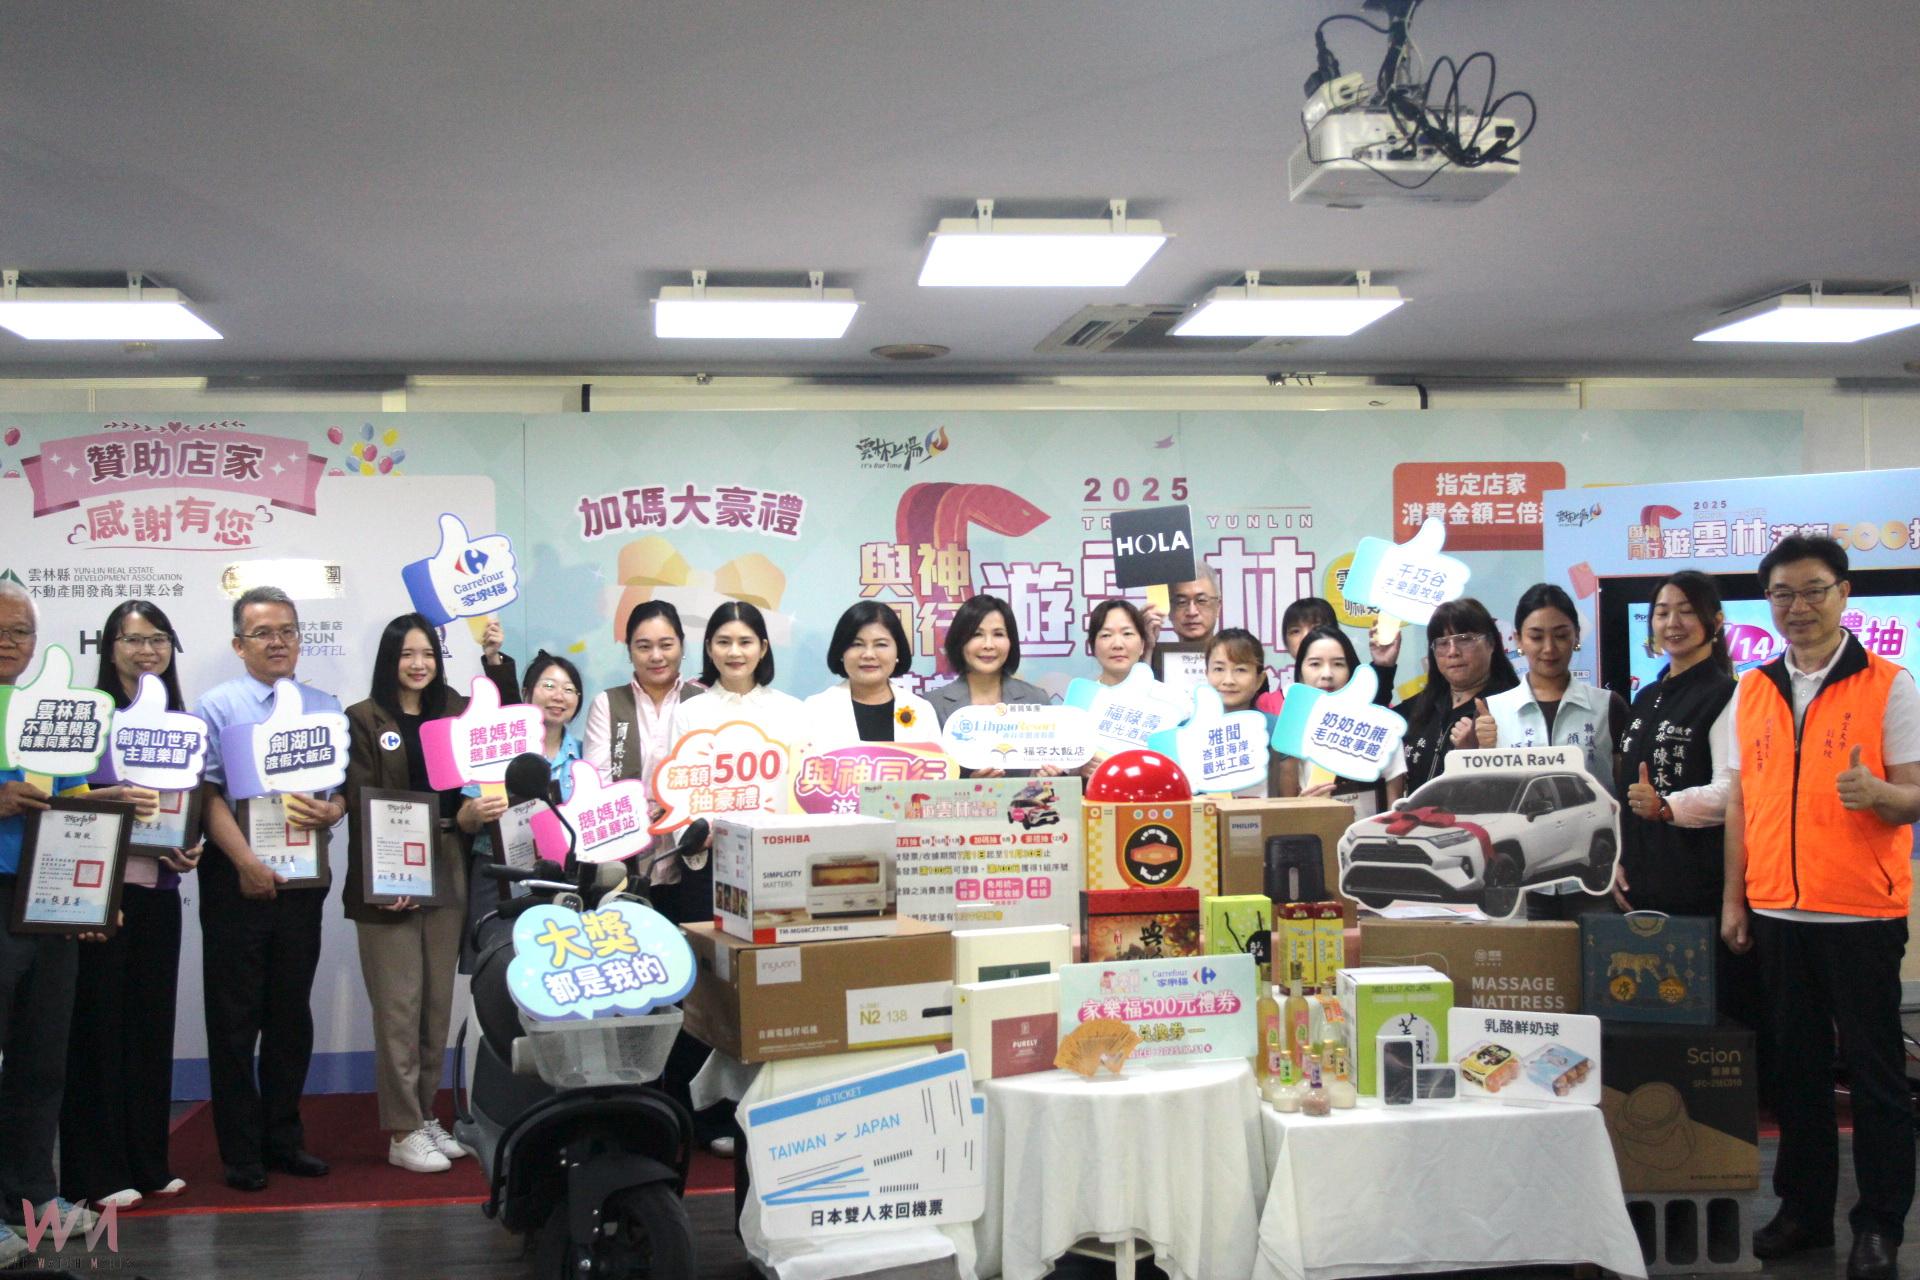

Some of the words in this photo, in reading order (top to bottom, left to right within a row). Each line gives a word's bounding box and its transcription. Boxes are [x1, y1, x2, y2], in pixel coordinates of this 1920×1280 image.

[1083, 477, 1189, 502] 2025
[1436, 472, 1527, 496] 指定店家
[578, 484, 803, 537] 加碼大豪禮
[1403, 502, 1543, 526] 消費金額三倍
[1694, 501, 1727, 510] 2025
[87, 496, 255, 545] 感謝有您
[1207, 515, 1314, 529] YUNLIN
[1116, 530, 1190, 557] HOLA
[28, 568, 71, 582] 雲林縣
[453, 570, 506, 595] Carrefour
[29, 583, 184, 598] 不動產開發商業同業公會
[460, 582, 508, 606] 家樂福
[36, 701, 94, 720] 雲林縣
[25, 719, 99, 737] 不動產開發
[118, 729, 198, 748] 劍湖山世界
[469, 719, 527, 747] 鵝媽媽
[1208, 723, 1241, 745] 雅聞
[1320, 711, 1388, 744] 奶奶的熊
[20, 735, 95, 749] 商業同業公會
[269, 727, 330, 753] 劍湖山
[469, 739, 527, 762] 鵝童樂園
[1314, 727, 1381, 756] 毛巾故事館
[125, 748, 188, 764] 主題樂園
[265, 748, 333, 770] 渡假大飯店
[1463, 755, 1523, 768] TOYOTA
[1527, 752, 1565, 766] Rav4
[667, 750, 781, 788] 滿額500
[690, 786, 760, 813] 抽豪禮
[578, 796, 633, 831] 鵝媽媽
[582, 815, 637, 846] 鵝童驛站
[1231, 822, 1259, 830] PHILIPS
[762, 834, 811, 845] TOSHIBA
[762, 870, 802, 879] SIMPLICITY
[536, 910, 640, 967] 大獎
[545, 955, 668, 1004] 都是我的
[1152, 969, 1188, 978] Carrefour
[1472, 977, 1555, 991] MASSAGE
[1082, 990, 1237, 1019] 家樂福500元禮券
[1472, 995, 1565, 1010] MATTRESS
[860, 1010, 880, 1025] N2
[887, 1010, 908, 1023] 138
[1484, 1018, 1559, 1037] 乳酪鮮奶球
[1012, 1039, 1038, 1048] PURELY
[1687, 1048, 1742, 1065] Scion
[816, 1095, 831, 1106] AIR
[832, 1086, 864, 1103] TICKET
[769, 1133, 828, 1161] TAIWAN
[853, 1113, 901, 1138] JAPAN
[811, 1199, 943, 1226] 日本雙人來回機票
